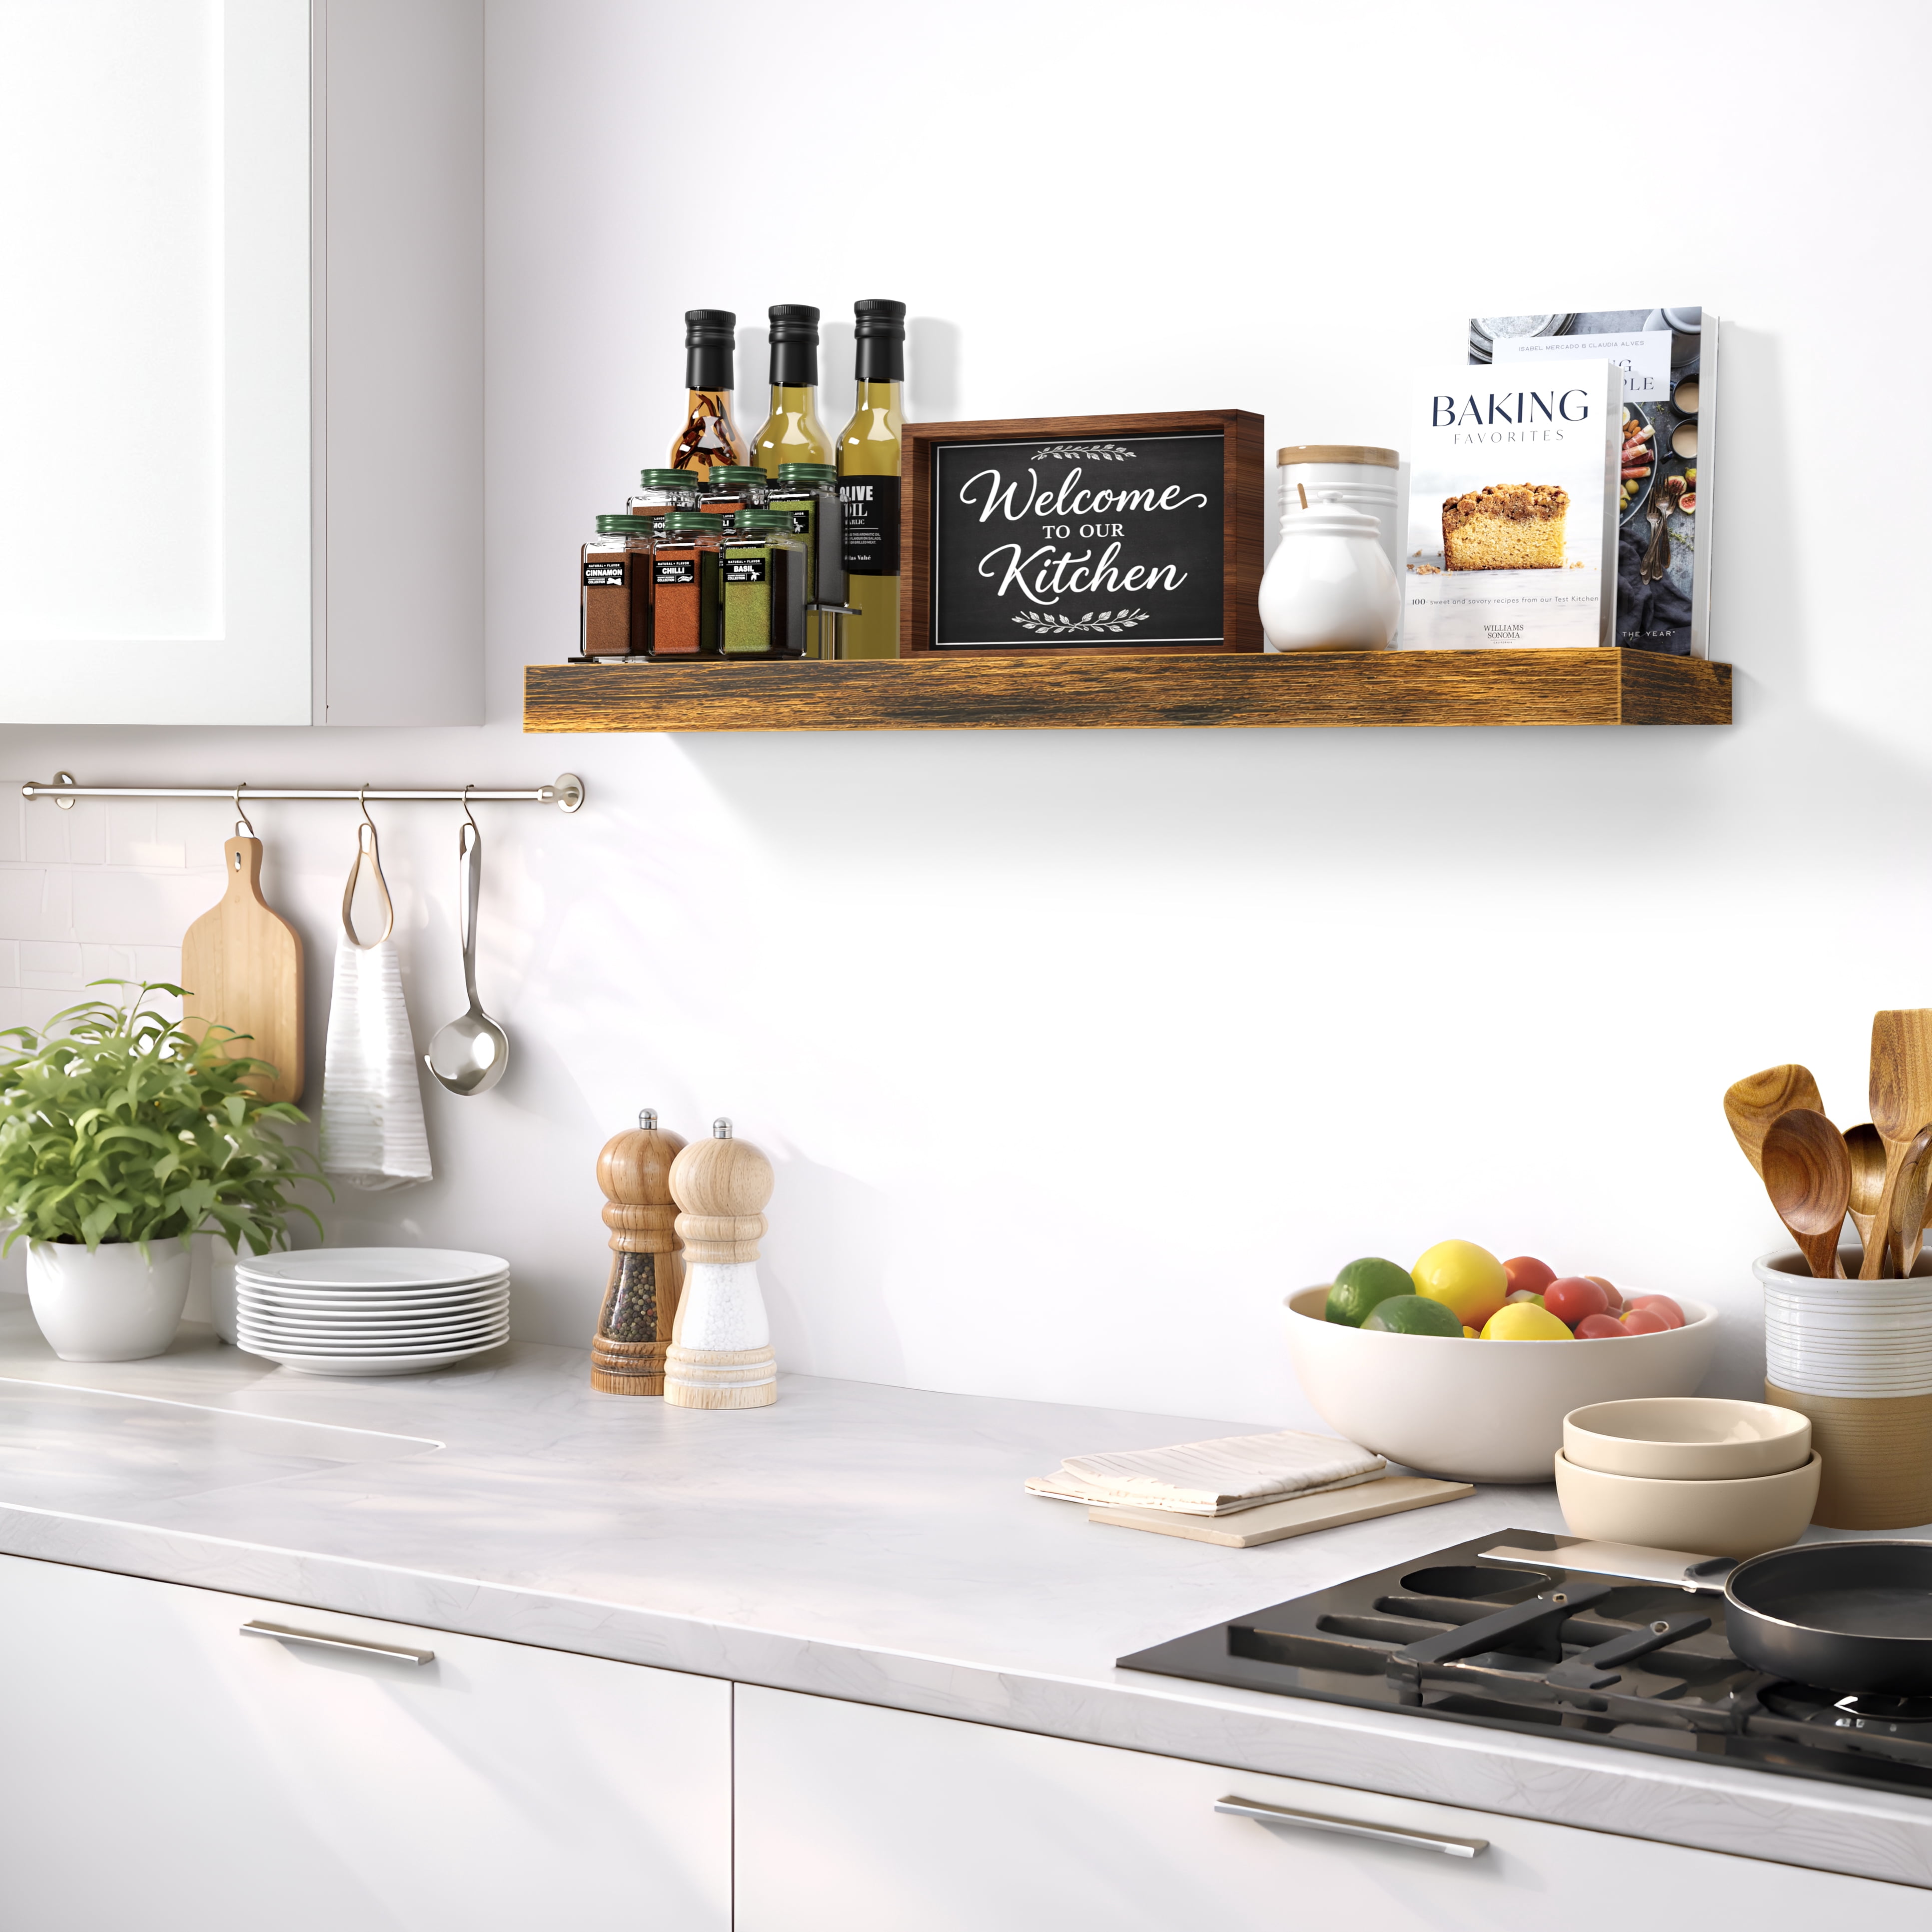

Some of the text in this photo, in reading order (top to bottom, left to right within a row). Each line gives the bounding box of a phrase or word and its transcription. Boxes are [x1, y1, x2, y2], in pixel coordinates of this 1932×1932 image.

[1432, 389, 1589, 427] BAKING
[1454, 429, 1564, 444] FAVORITES
[840, 486, 873, 502] OLIVE
[960, 468, 1207, 523] Welcome
[1042, 523, 1124, 539] TO OUR
[978, 542, 1187, 605] Kitchen
